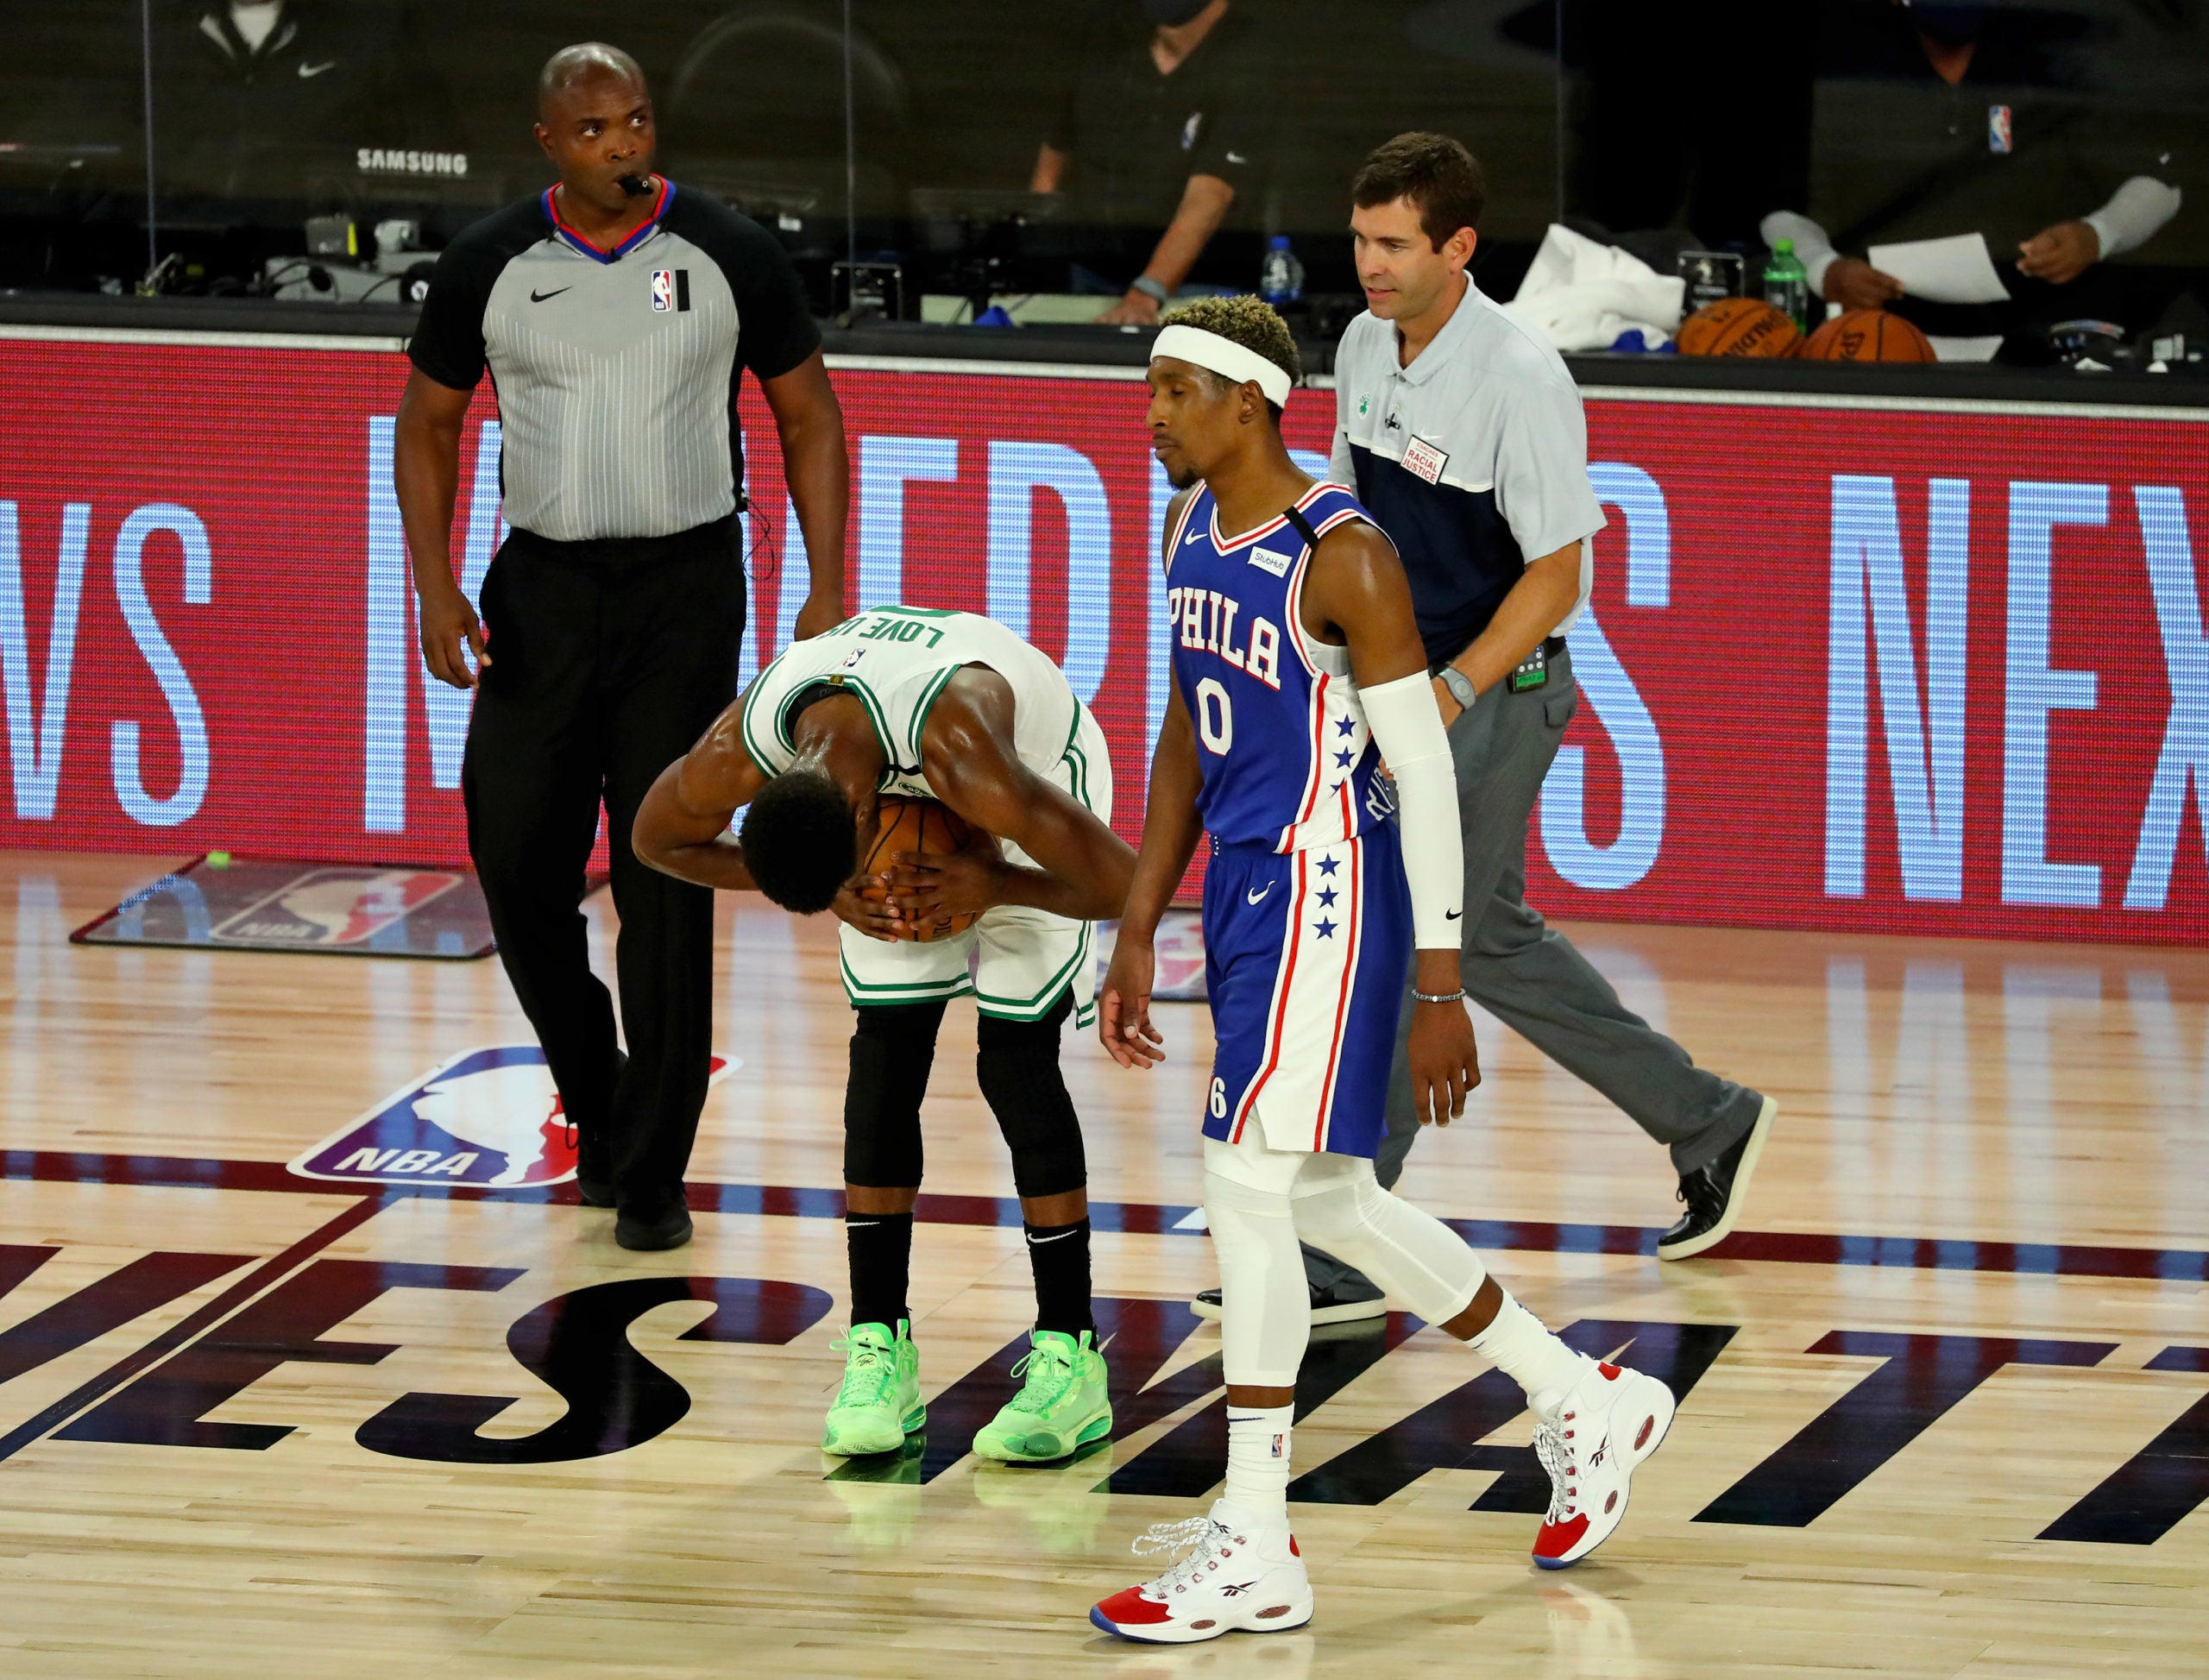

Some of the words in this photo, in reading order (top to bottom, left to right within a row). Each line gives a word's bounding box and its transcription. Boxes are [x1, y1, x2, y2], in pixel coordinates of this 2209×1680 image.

[357, 148, 467, 175] SAMSUNG
[1402, 457, 1438, 483] JUSTICE
[1407, 449, 1438, 473] RACIAL
[1254, 551, 1285, 570] StubHub
[859, 617, 946, 649] LOVE
[1168, 587, 1281, 691] PHILA
[1196, 676, 1233, 757] 0
[332, 1147, 480, 1176] NBA
